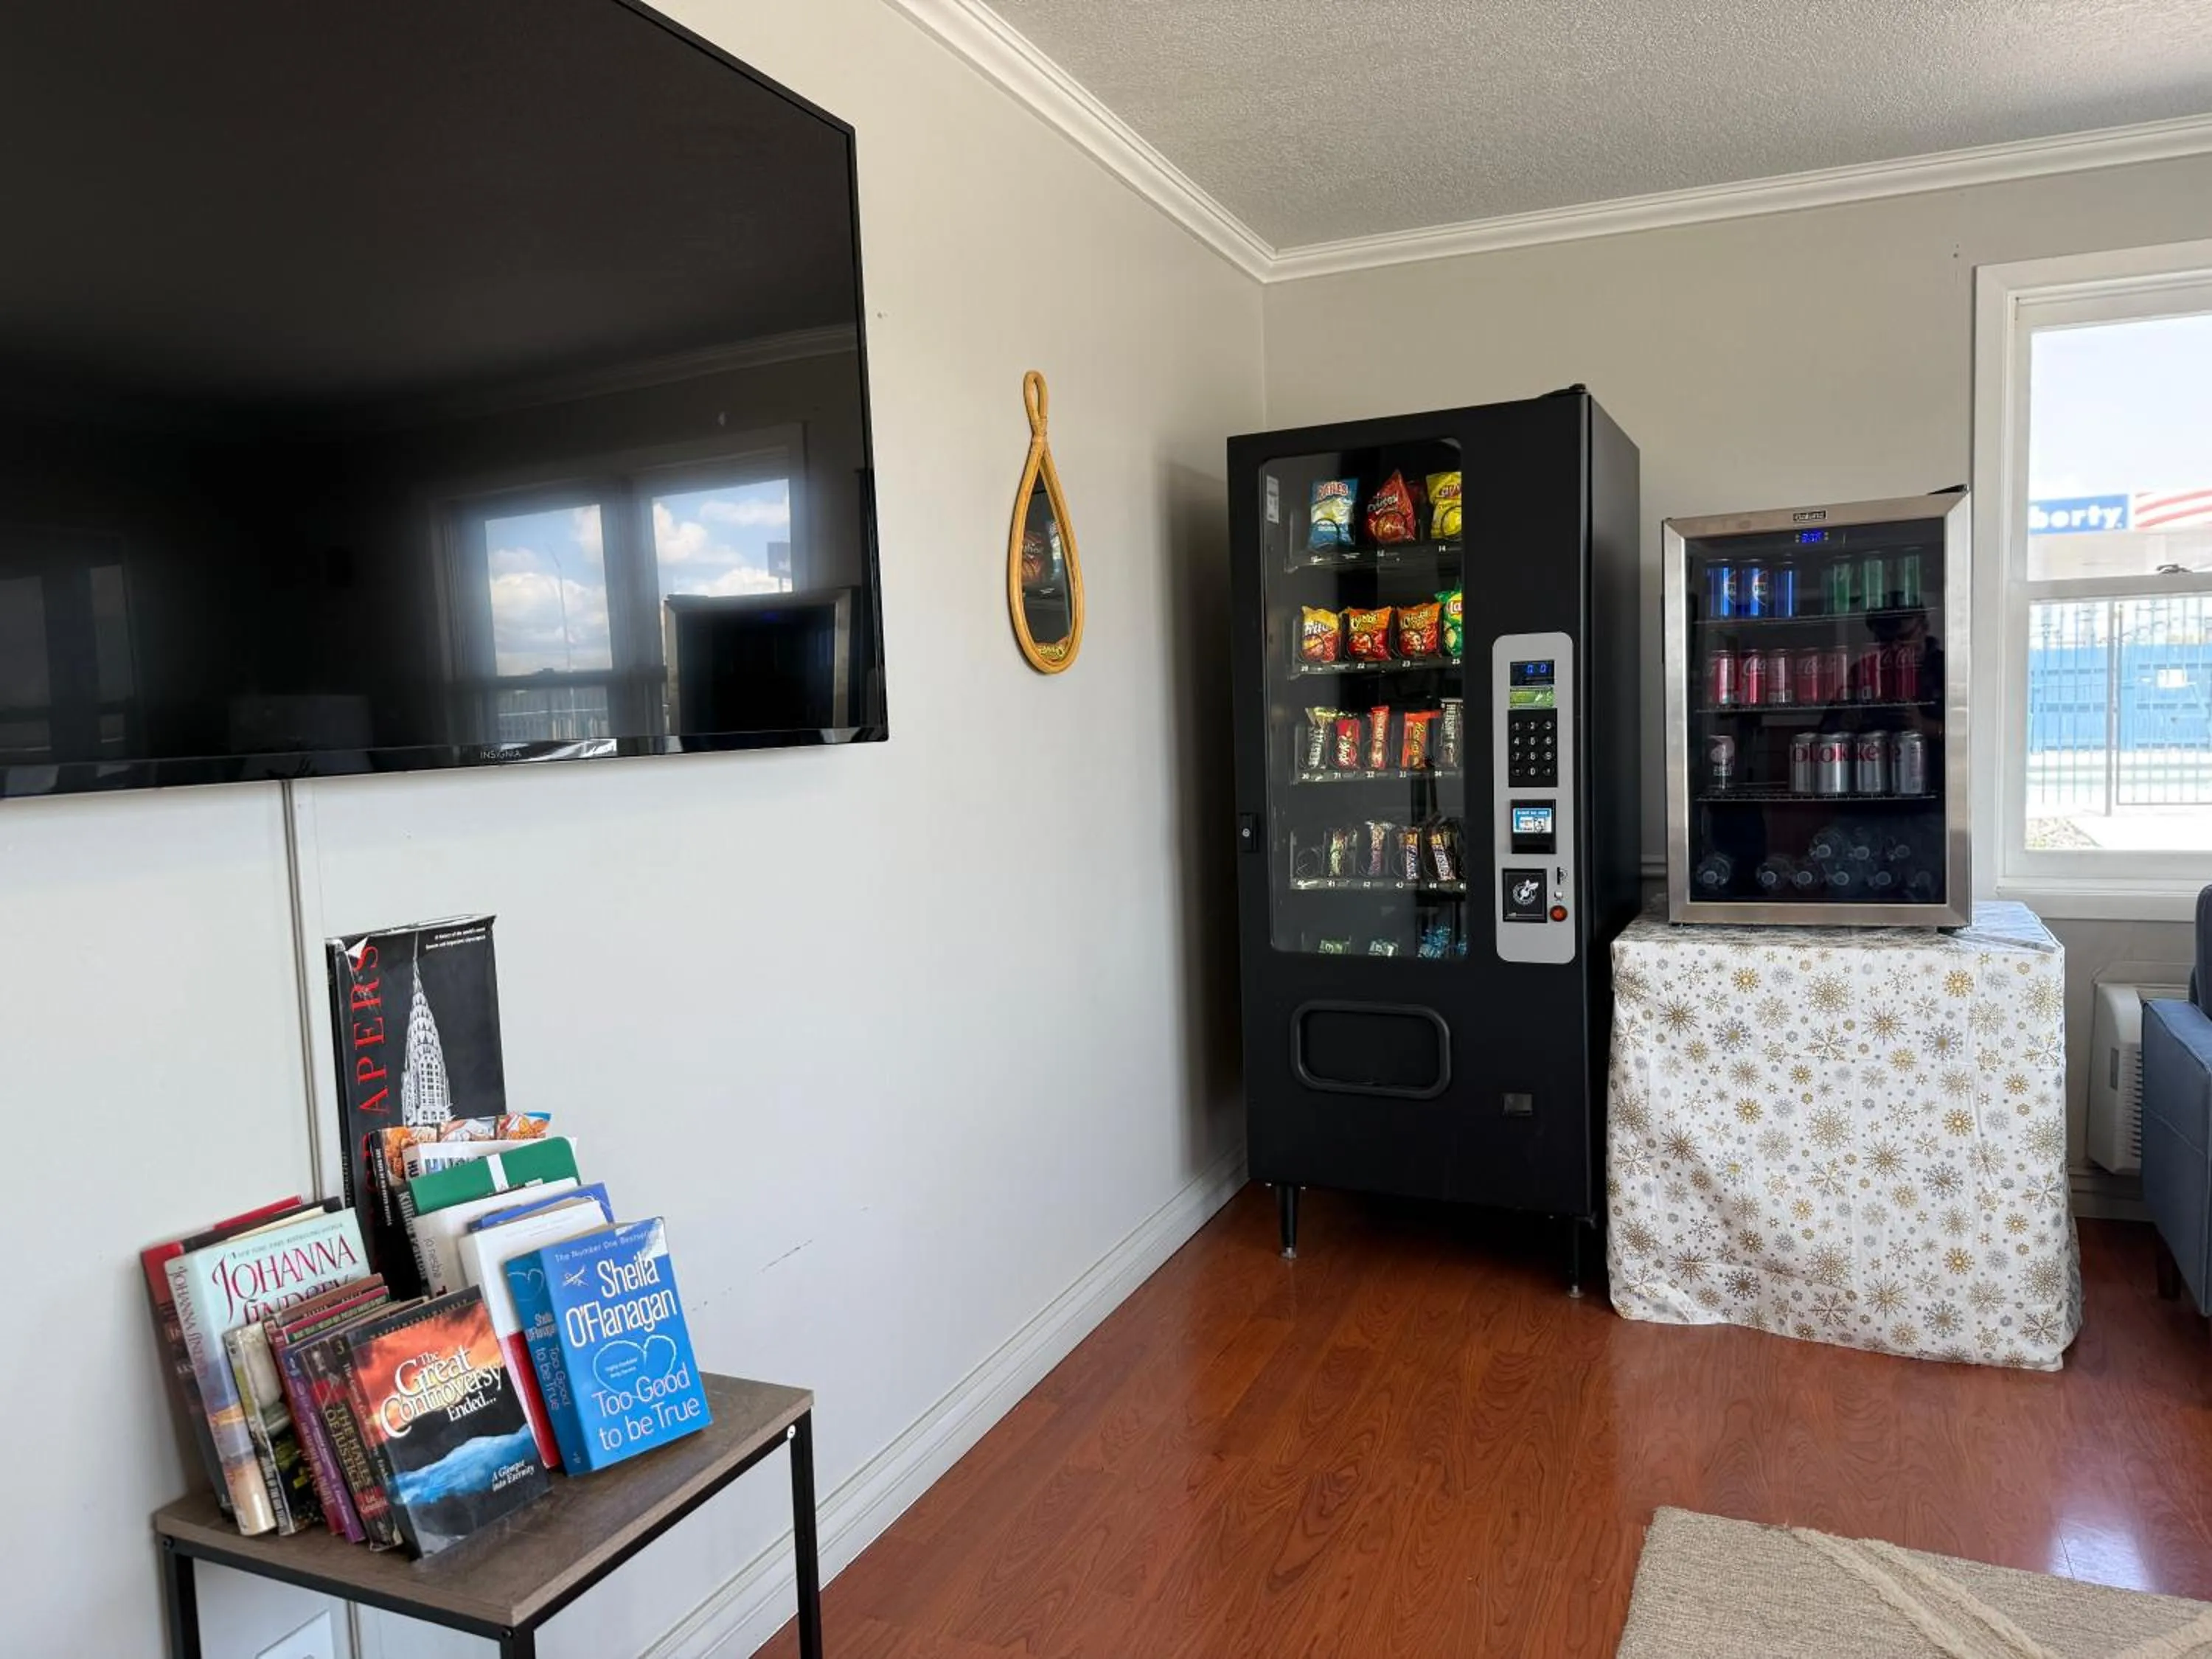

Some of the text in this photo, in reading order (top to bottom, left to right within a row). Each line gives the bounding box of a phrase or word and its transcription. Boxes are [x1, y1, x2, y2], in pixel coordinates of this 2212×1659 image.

[480, 751, 522, 759] INSIGNIA
[212, 1234, 359, 1323] JOHANNA
[597, 1251, 661, 1298] Sheila
[566, 1289, 678, 1348] O'Flanagan
[394, 1344, 472, 1397] Great
[416, 1350, 440, 1365] The
[379, 1363, 503, 1439] Controversy
[592, 1390, 633, 1418] Too
[636, 1362, 690, 1402] Good
[337, 1402, 355, 1435] THE
[599, 1397, 700, 1450] to be True
